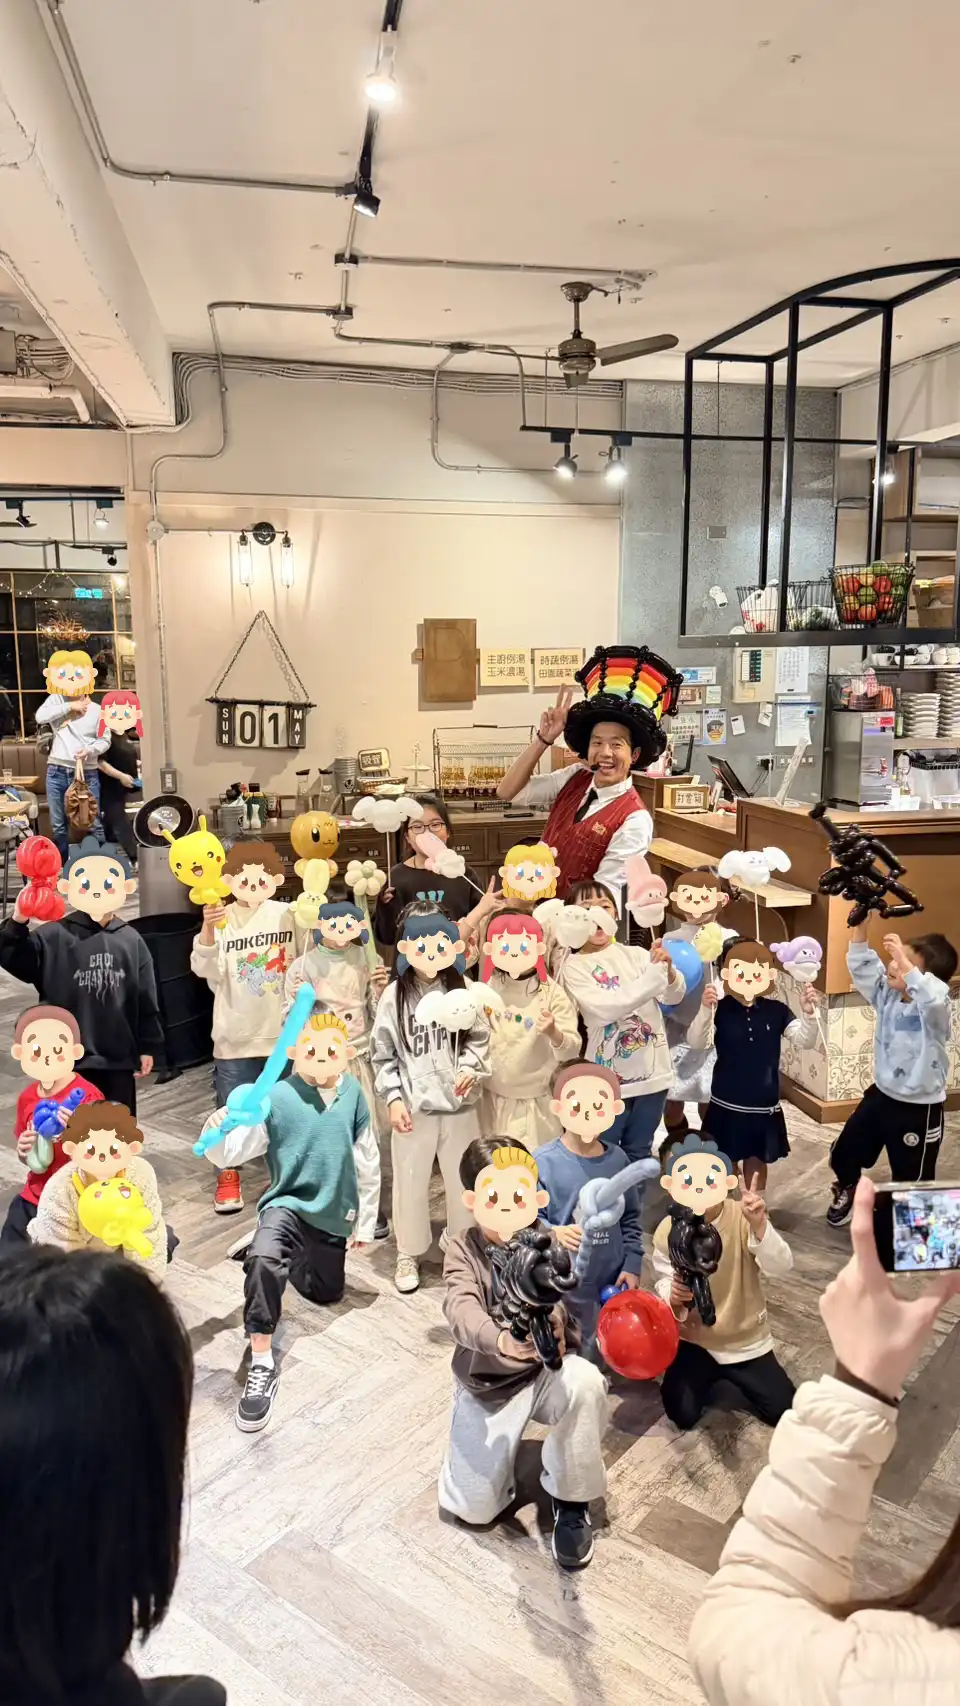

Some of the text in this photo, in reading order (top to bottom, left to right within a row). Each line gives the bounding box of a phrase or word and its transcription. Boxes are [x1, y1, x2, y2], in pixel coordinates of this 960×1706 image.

[487, 653, 526, 665] 主廚例湯
[540, 654, 579, 666] 時蔬例湯
[487, 666, 526, 677] 玉米濃湯
[293, 709, 303, 744] MAY
